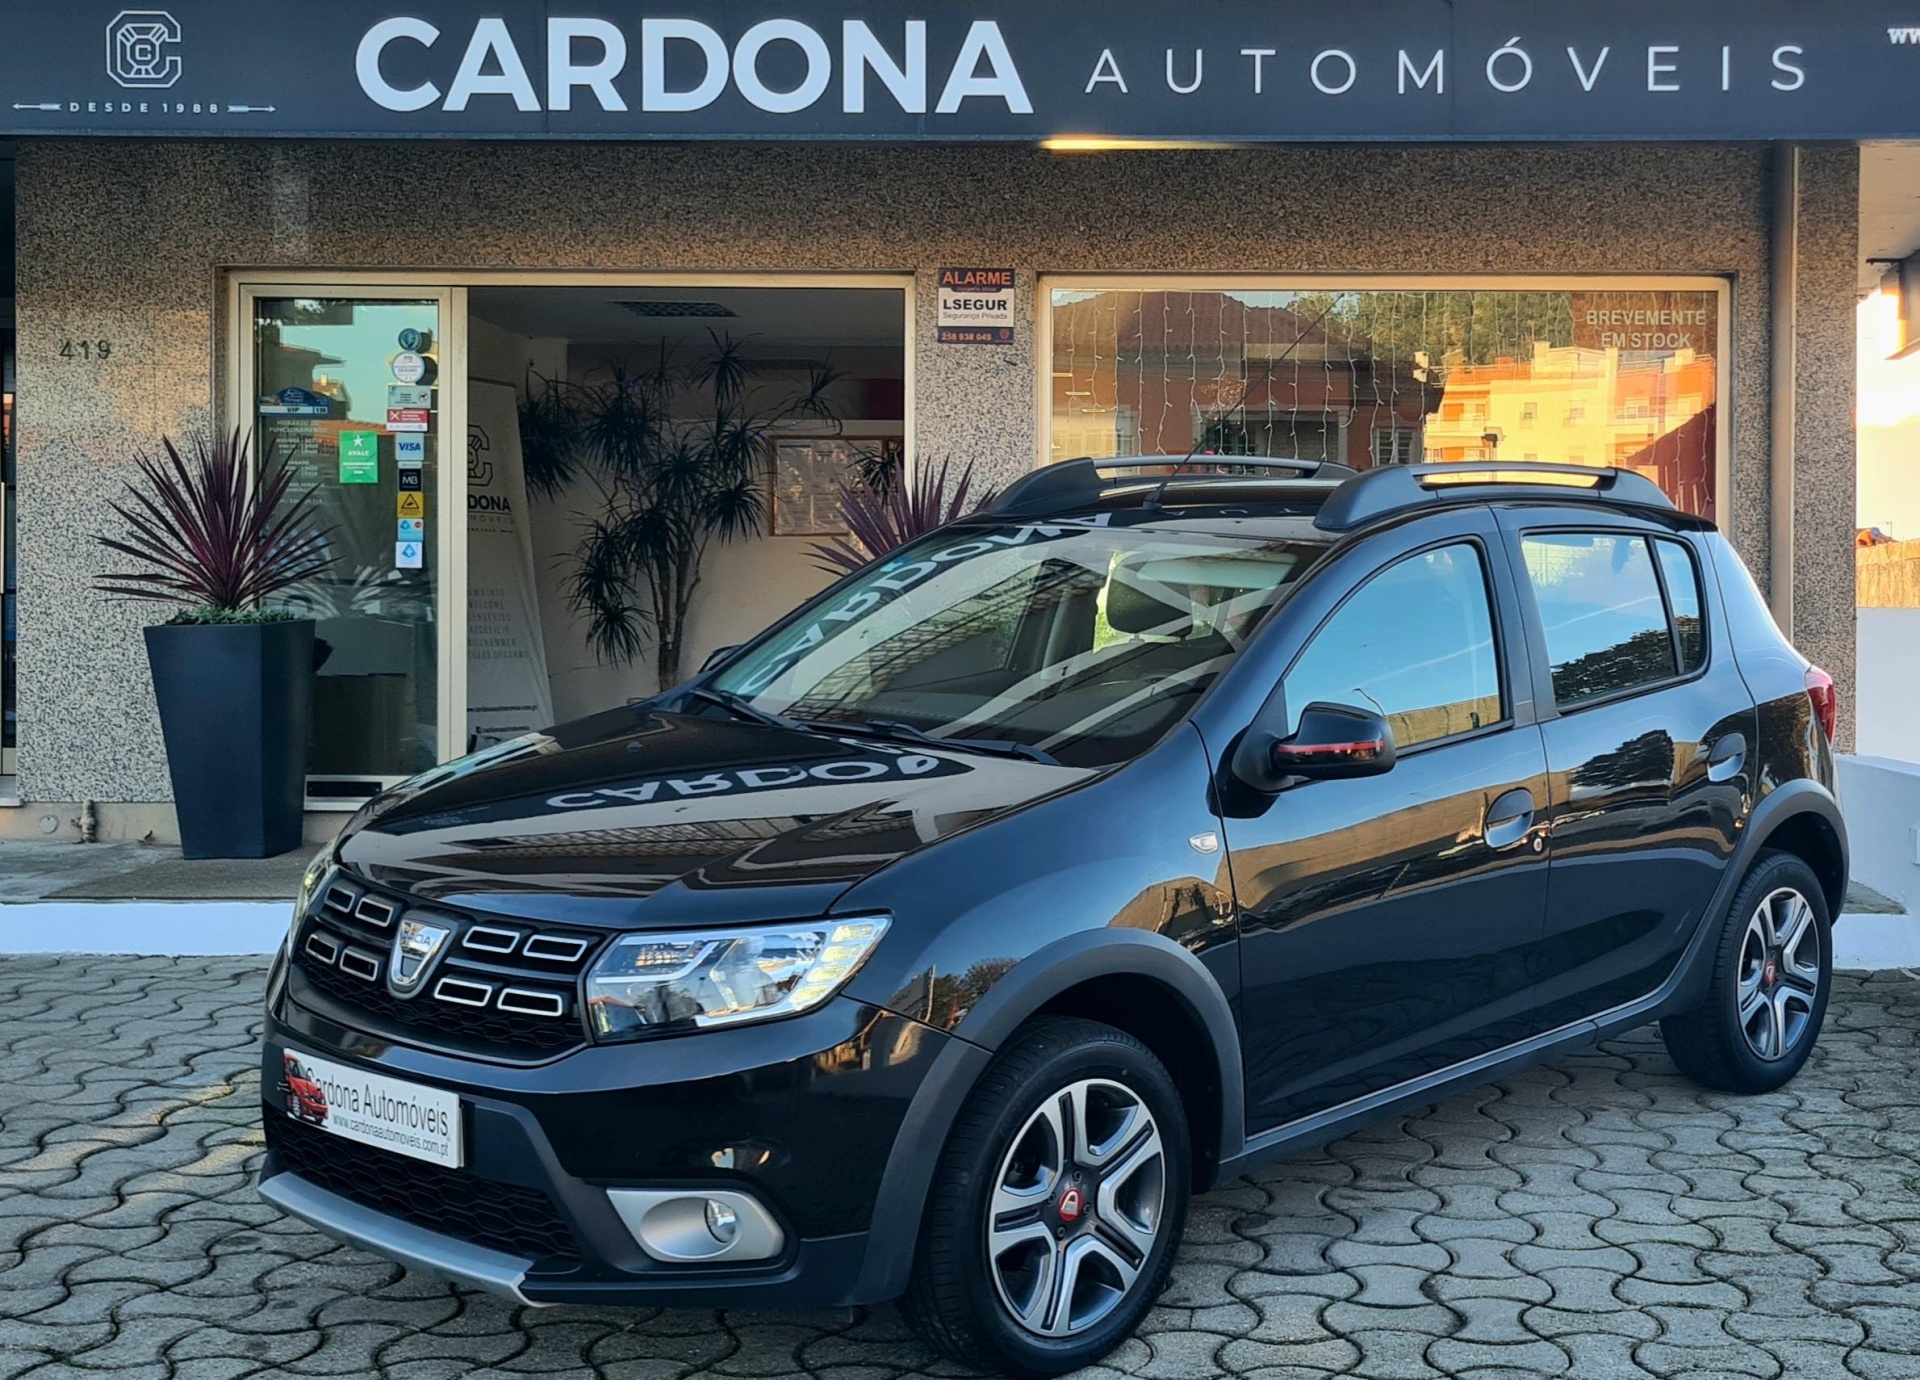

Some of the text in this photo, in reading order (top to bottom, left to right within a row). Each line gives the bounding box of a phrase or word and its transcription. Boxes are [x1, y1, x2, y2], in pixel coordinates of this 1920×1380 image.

[356, 17, 1806, 115] CARDONA AUTOMÓVEIS
[70, 103, 218, 113] DESDE 1988
[943, 271, 1011, 285] ALARME
[943, 299, 1008, 311] LSEGUR
[943, 312, 1008, 320] Segurança Privada
[1586, 310, 1707, 326] BREVEMENTE
[1600, 332, 1692, 348] EM STOCK
[59, 340, 110, 359] 419
[398, 442, 421, 451] VISA
[402, 476, 418, 485] MB
[363, 1083, 449, 1137] Automóveis
[332, 1113, 449, 1159] www.cardonaautomoveis.com.pt
